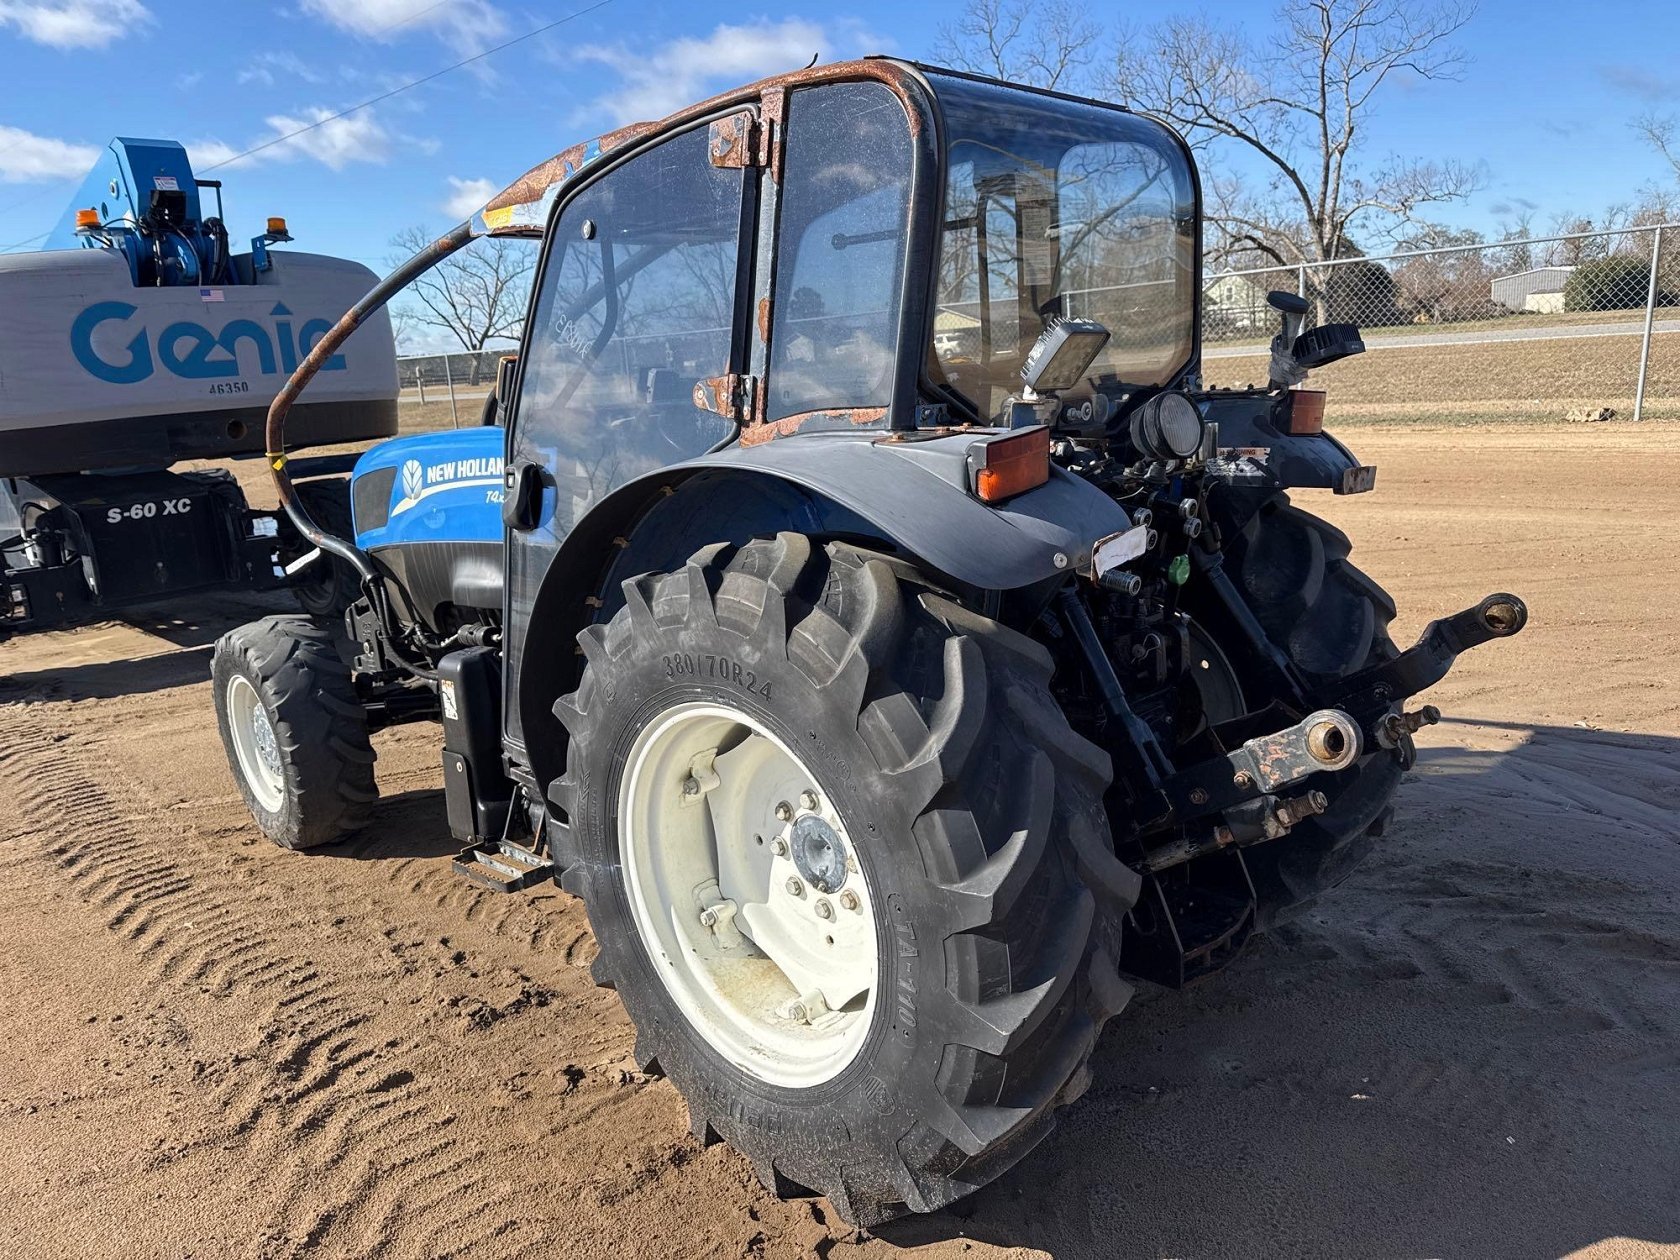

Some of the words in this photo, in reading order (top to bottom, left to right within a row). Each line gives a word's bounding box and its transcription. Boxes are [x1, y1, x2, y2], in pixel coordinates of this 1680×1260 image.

[70, 300, 348, 384] Genie
[208, 380, 249, 395] 46350
[427, 462, 455, 483] NEW
[457, 457, 505, 478] HOLLAN
[106, 502, 157, 524] S-60
[162, 497, 192, 516] XC
[662, 652, 774, 702] 380/70R24
[892, 919, 921, 1029] TA-110
